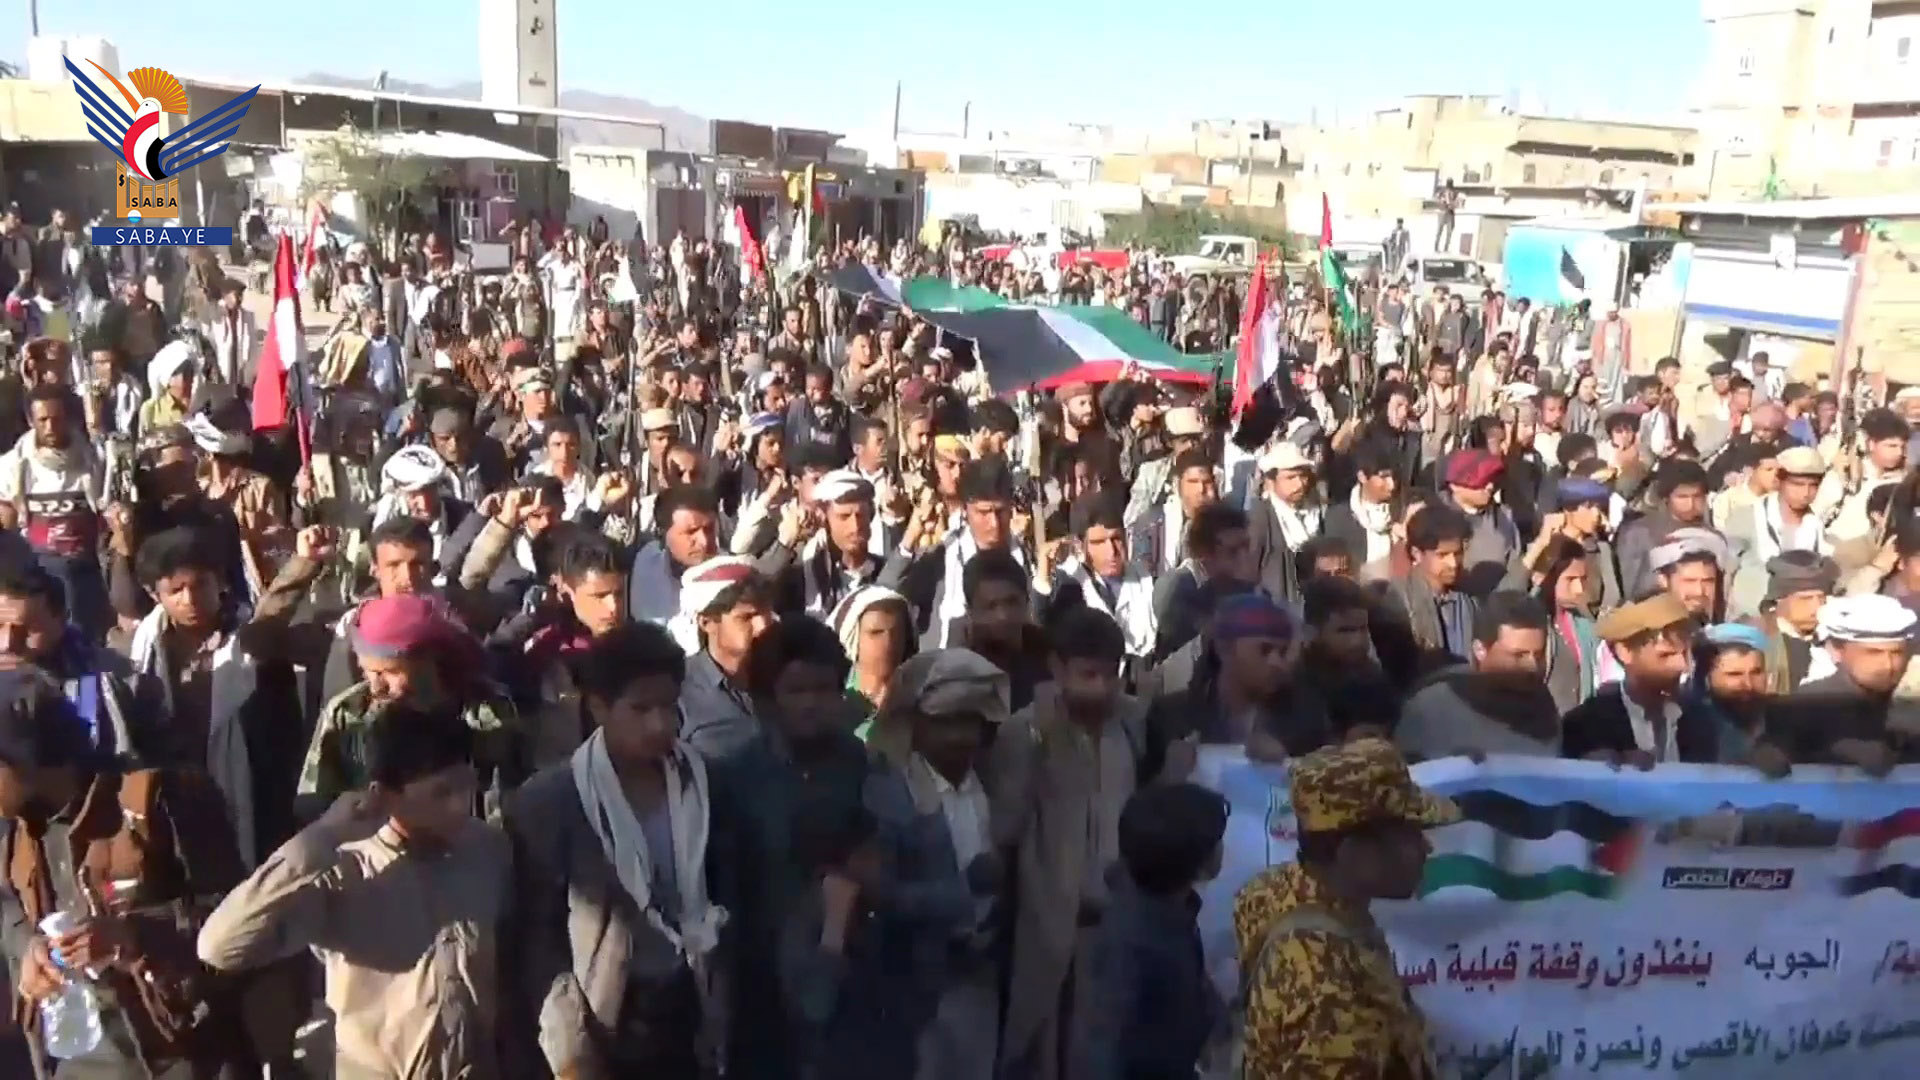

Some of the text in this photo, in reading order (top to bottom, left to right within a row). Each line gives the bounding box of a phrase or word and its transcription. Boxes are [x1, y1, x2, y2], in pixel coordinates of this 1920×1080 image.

[1446, 940, 1520, 992] قبلية
[1527, 940, 1599, 990] وقفة
[1604, 936, 1713, 988] ينفذون
